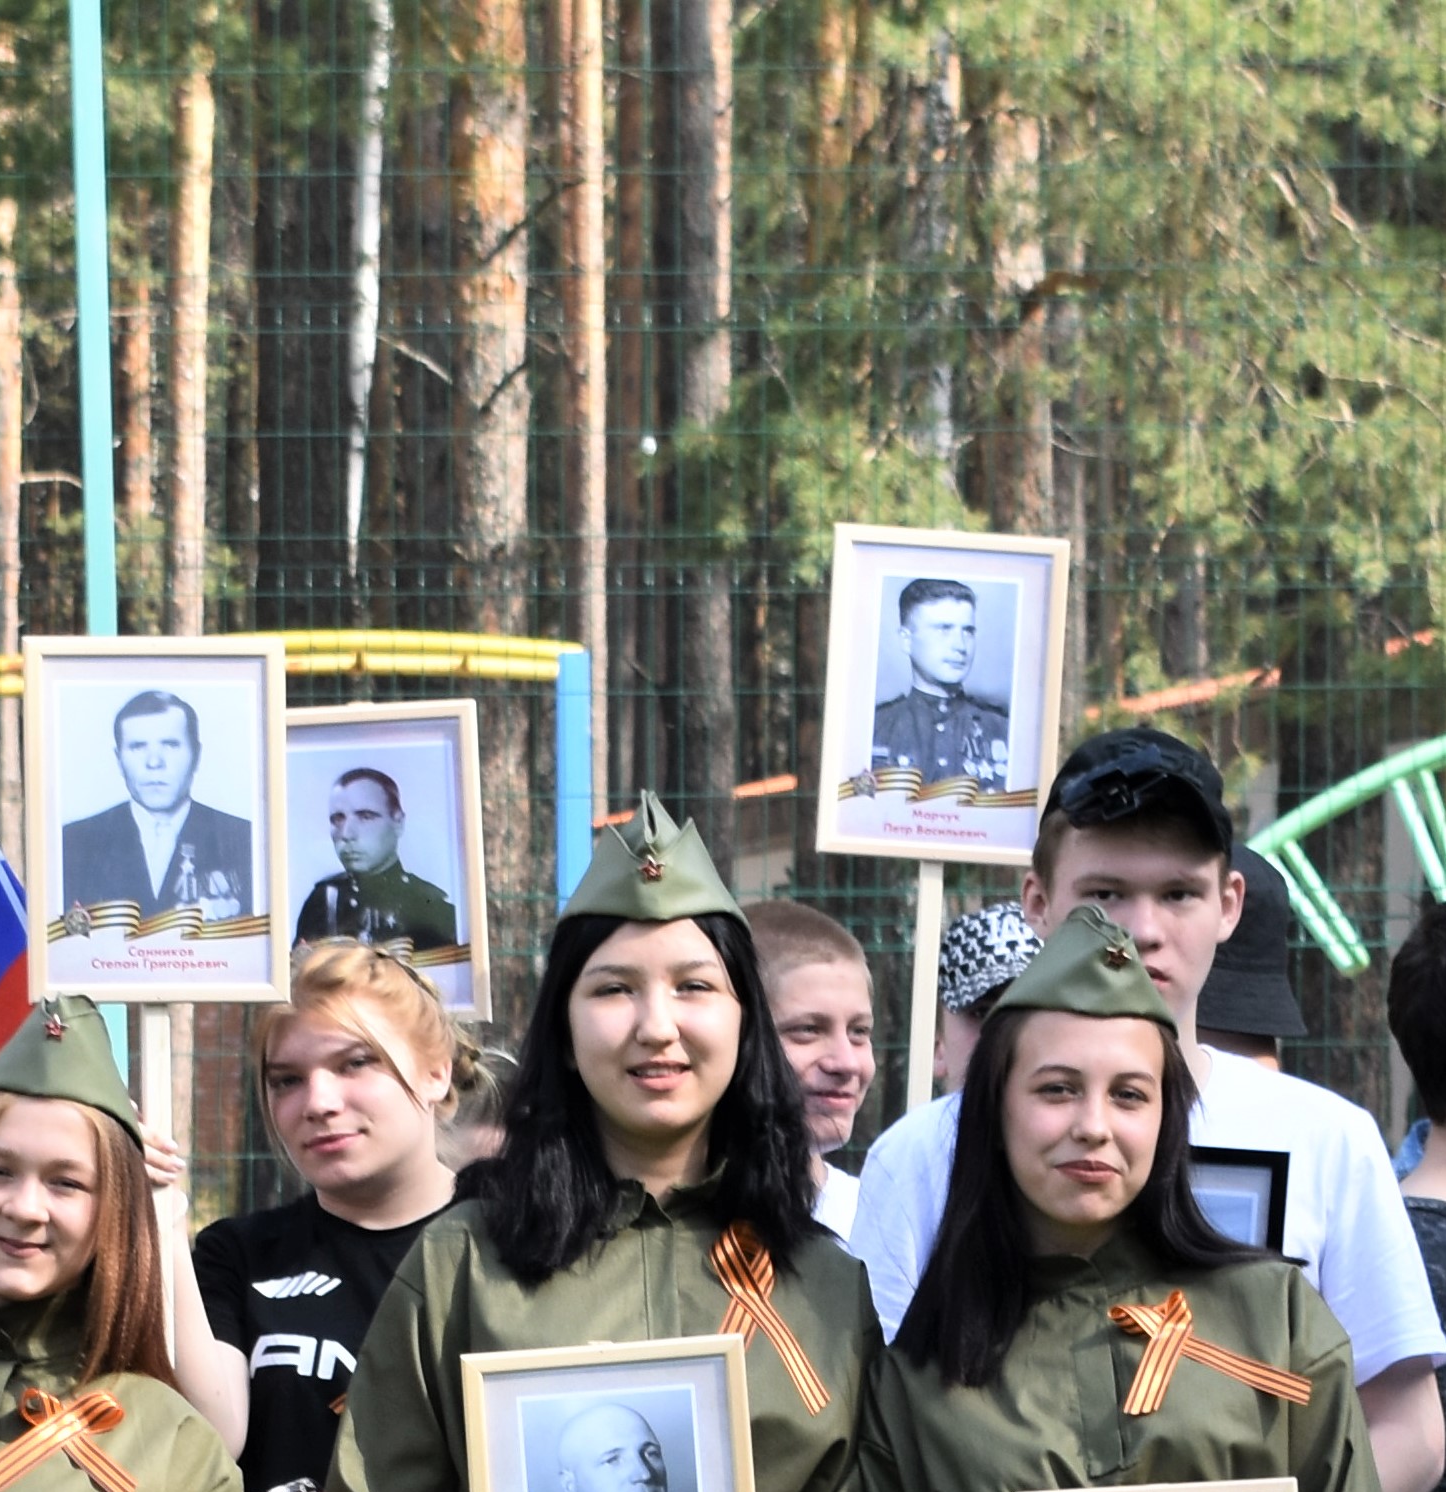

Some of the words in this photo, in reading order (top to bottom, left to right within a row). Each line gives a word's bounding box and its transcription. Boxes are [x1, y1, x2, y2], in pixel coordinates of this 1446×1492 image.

[912, 809, 961, 822] Марчук
[916, 825, 988, 839] Васильевич
[127, 946, 195, 958] Санников
[91, 958, 139, 970] Степан
[143, 958, 230, 972] Григорьевич
